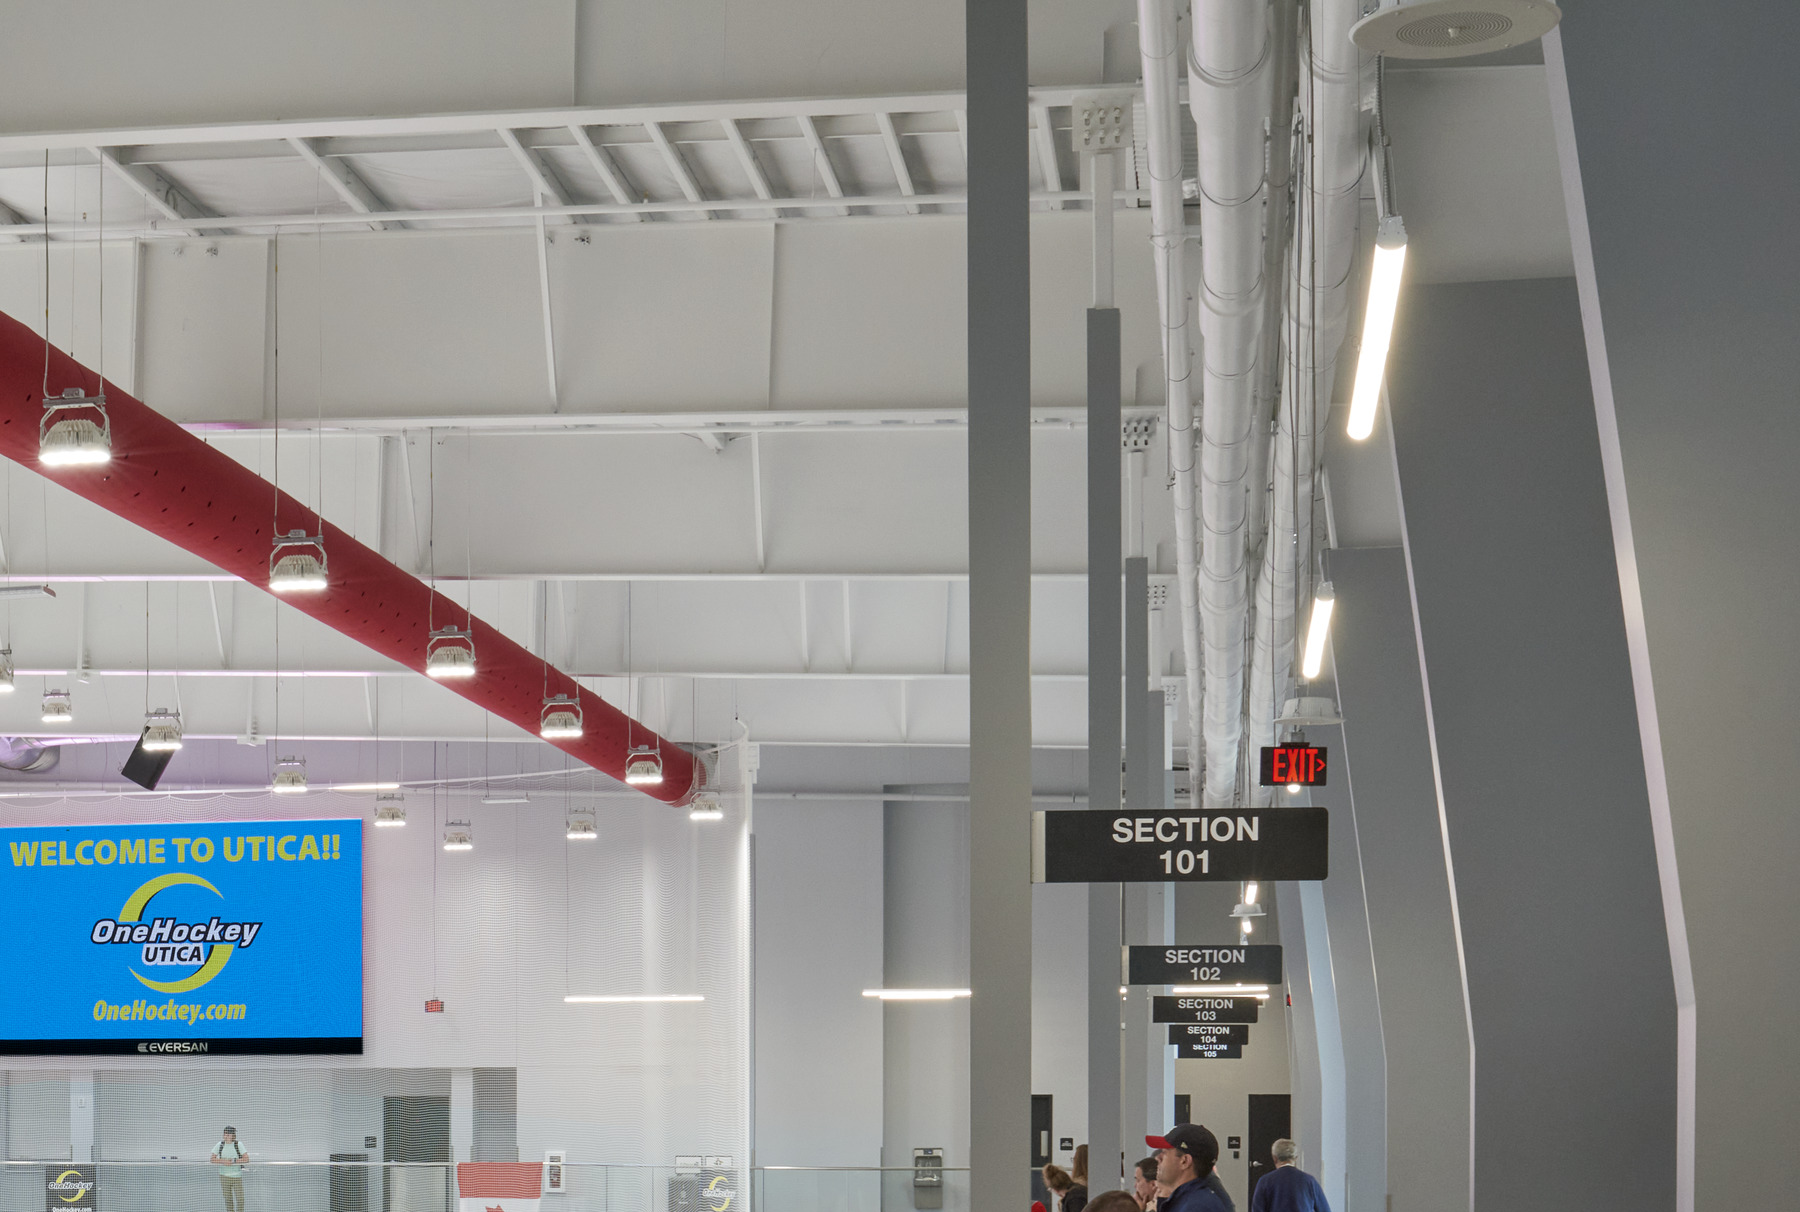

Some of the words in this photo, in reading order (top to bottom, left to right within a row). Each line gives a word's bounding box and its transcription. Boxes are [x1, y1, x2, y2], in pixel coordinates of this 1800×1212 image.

[1272, 748, 1318, 783] EXIT
[1112, 816, 1259, 843] SECTION
[9, 838, 166, 867] WELCOME
[172, 836, 215, 863] TO
[223, 834, 341, 862] UTICA!!
[1159, 849, 1211, 875] 101
[90, 916, 264, 948] OneHockey
[143, 945, 203, 964] UTICA
[1164, 949, 1246, 964] SECTION
[1190, 967, 1221, 981] 102
[92, 998, 247, 1026] OneHockey.com
[1177, 999, 1234, 1010] SECTION
[1195, 1010, 1217, 1021] 103
[1187, 1026, 1230, 1035] SECTION
[1201, 1035, 1217, 1043] 104
[149, 1042, 208, 1053] EVERSAN
[48, 1181, 94, 1190] OneHockey
